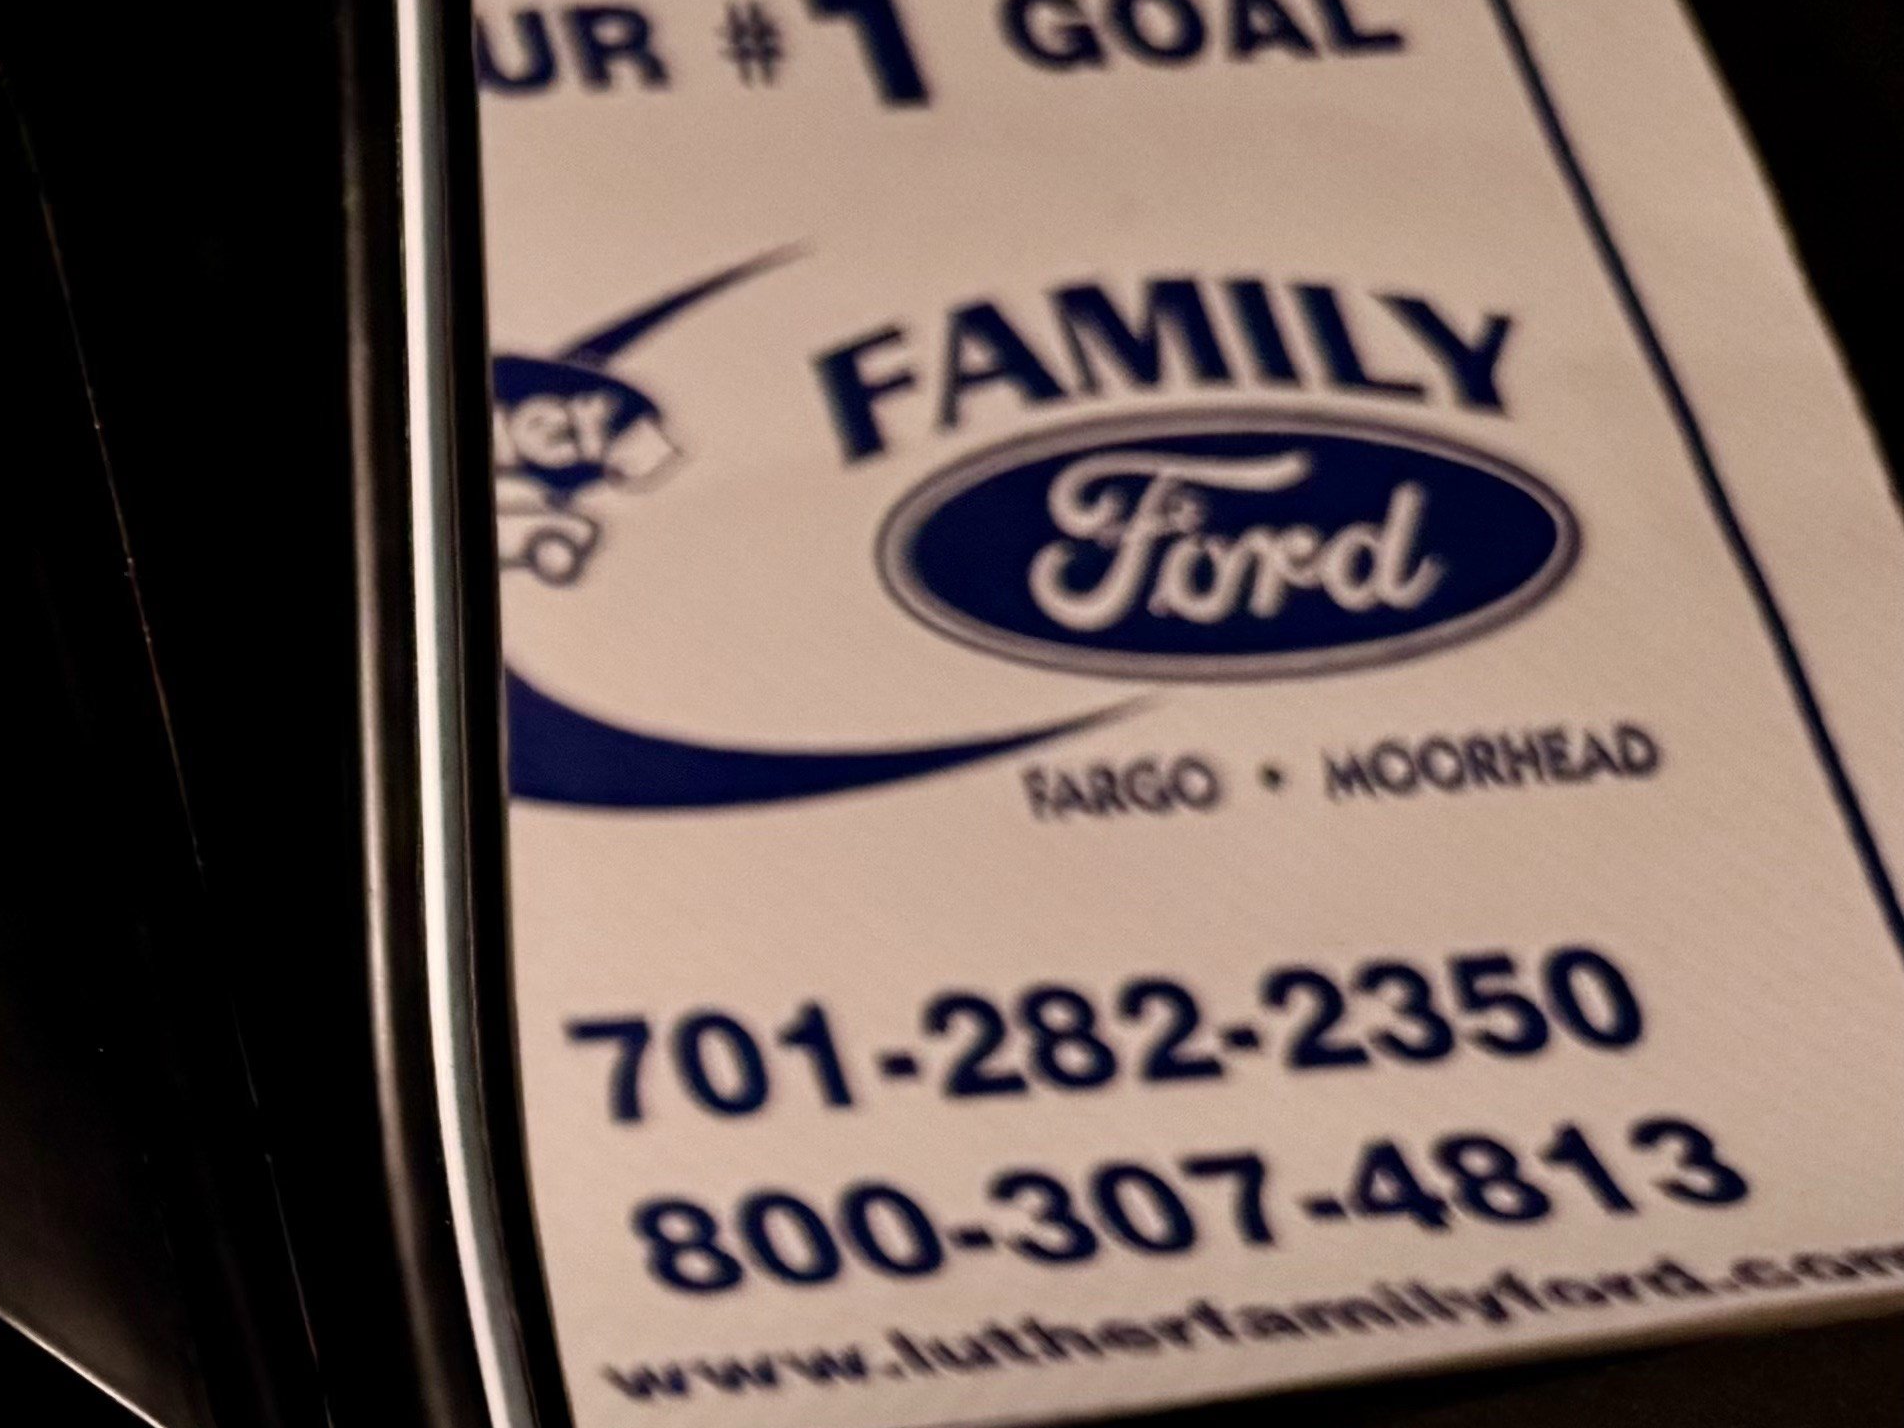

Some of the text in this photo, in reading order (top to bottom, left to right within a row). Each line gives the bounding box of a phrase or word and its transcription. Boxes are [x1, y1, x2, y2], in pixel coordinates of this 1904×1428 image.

[476, 2, 671, 98] UR
[814, 276, 1514, 464] FAMILY
[1030, 451, 1453, 629] Ford
[1021, 720, 1665, 820] FARGO MOORHEAD
[566, 944, 1646, 1124] 701-282-2350
[632, 1116, 1751, 1297] 800-307-4813
